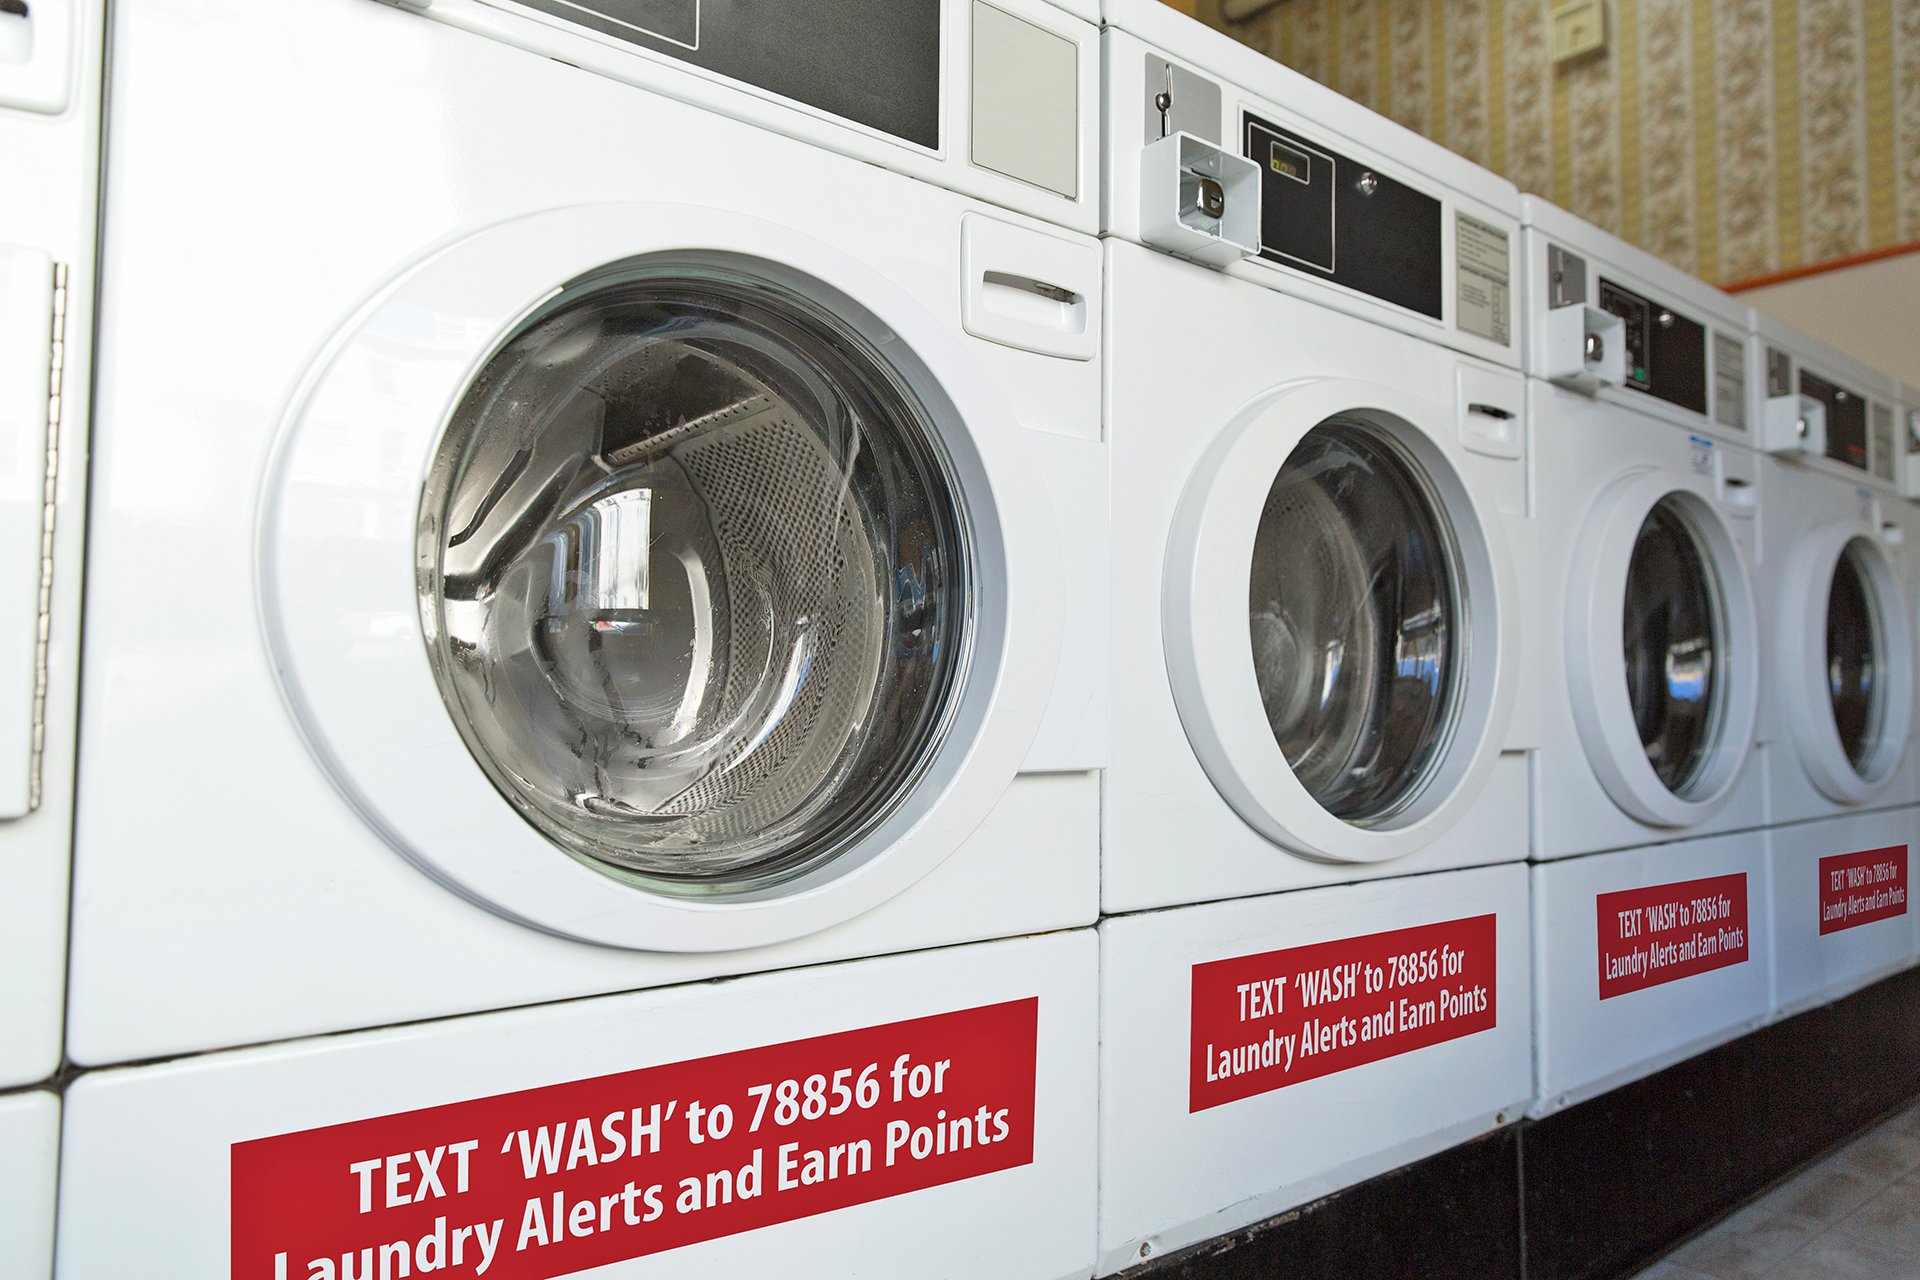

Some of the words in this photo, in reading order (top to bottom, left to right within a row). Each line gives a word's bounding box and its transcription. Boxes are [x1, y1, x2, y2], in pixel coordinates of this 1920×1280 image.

[1605, 946, 1648, 980] Laundry
[1649, 941, 1678, 970] Alerts
[1679, 933, 1697, 962] and
[1698, 932, 1717, 958] Earn
[1718, 926, 1744, 952] Points
[1618, 908, 1642, 939] TEXT
[1645, 902, 1679, 933] 'WASH'
[1679, 903, 1690, 927] to
[1691, 896, 1718, 924] 78856
[1718, 893, 1732, 919] for
[1237, 976, 1287, 1022] TEXT
[1294, 961, 1362, 1008] 'WASH'
[1364, 964, 1383, 994] to
[1387, 948, 1438, 989] 78856
[1441, 944, 1465, 977] for
[1206, 1029, 1297, 1083] Laundry
[1300, 1015, 1358, 1058] Alerts
[1360, 1000, 1395, 1042] and
[1399, 997, 1436, 1032] Earn
[1440, 984, 1488, 1022] Points
[350, 1138, 479, 1214] TEXT
[500, 1100, 678, 1180] 'WASH'
[685, 1099, 734, 1145] to
[747, 1062, 880, 1133] 78856
[890, 1053, 951, 1103] for
[515, 1180, 664, 1252] Alerts
[675, 1147, 763, 1214] and
[777, 1138, 872, 1192] Earn
[885, 1104, 1010, 1167] Points
